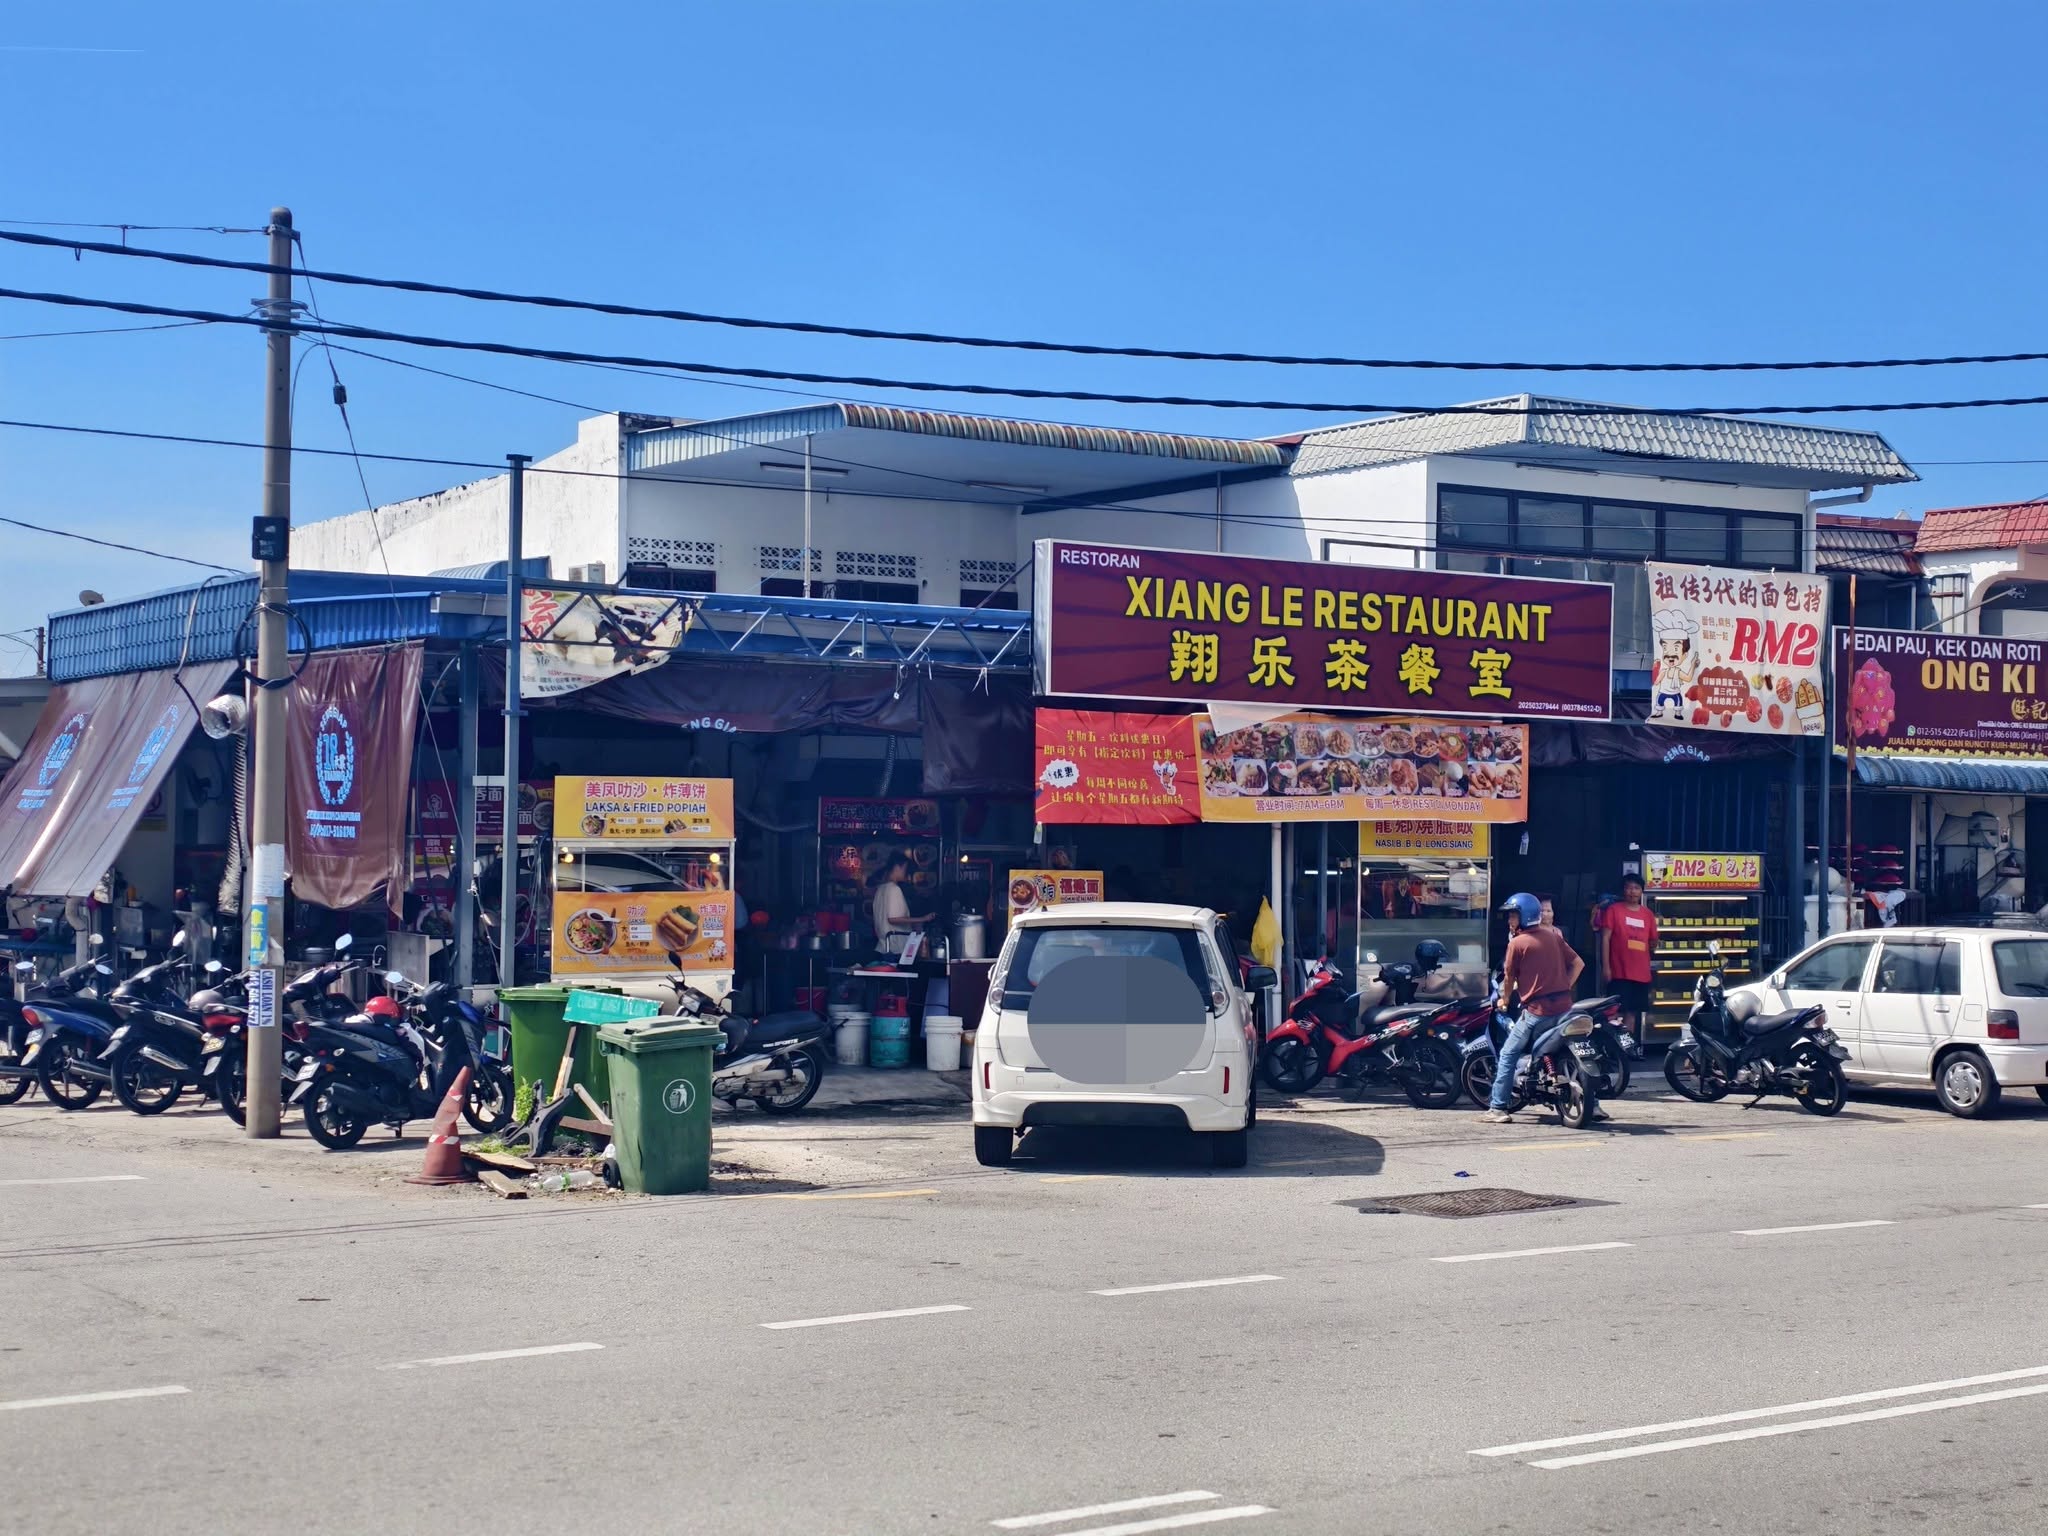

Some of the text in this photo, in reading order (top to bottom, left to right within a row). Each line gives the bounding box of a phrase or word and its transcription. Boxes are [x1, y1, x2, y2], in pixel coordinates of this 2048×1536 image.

[1060, 549, 1140, 569] RESTORAN
[1125, 575, 1552, 642] XIANG LE RESTAURANT
[1729, 617, 1819, 667] RM2
[1896, 636, 1931, 657] PAU,
[1935, 639, 1968, 657] KEK
[1971, 641, 2003, 659] DAN
[2006, 644, 2041, 661] ROTI
[1170, 630, 1512, 699] 翔乐茶餐室
[1921, 659, 2036, 694] ONG KI
[1887, 737, 1915, 746] JUALAN
[1916, 738, 1947, 747] BORONG
[1664, 745, 1711, 763] SENG GIAP
[1053, 767, 1074, 780] 优惠
[585, 802, 706, 813] LAKSA & FRIED POPIAH
[1375, 839, 1393, 847] NASI
[1449, 841, 1473, 849] SIANG
[1673, 859, 1706, 877] RM2
[262, 970, 273, 990] CASH
[262, 992, 273, 1011] LOAN
[1575, 1041, 1591, 1049] PFX
